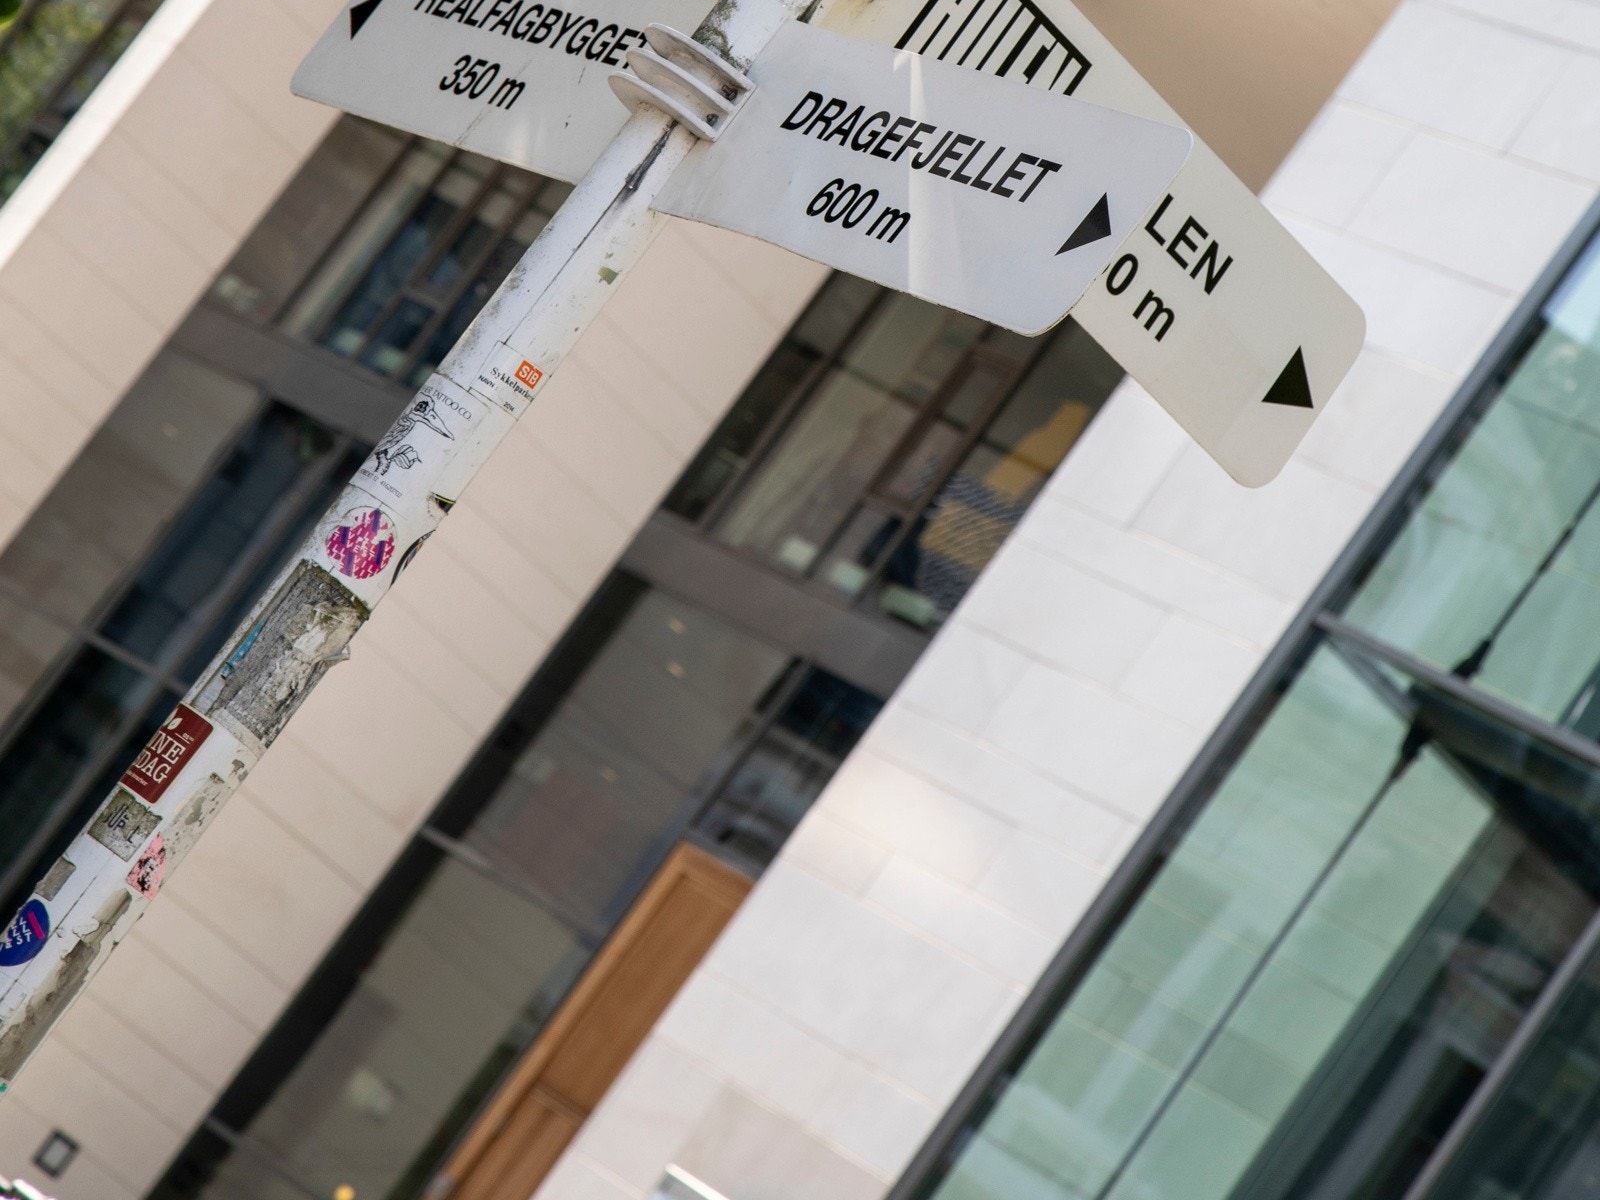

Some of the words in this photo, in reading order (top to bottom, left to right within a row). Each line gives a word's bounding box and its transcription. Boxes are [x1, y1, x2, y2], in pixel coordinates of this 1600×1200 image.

[439, 54, 501, 100] 350
[487, 77, 526, 110] m
[779, 90, 1063, 203] DRAGEFJELLET
[805, 177, 880, 230] 600
[867, 206, 911, 244] m
[1144, 193, 1234, 295] LEN
[1101, 253, 1139, 296] 0
[1132, 289, 1175, 342] m
[434, 389, 460, 411] TATTOO
[459, 406, 472, 421] CO.
